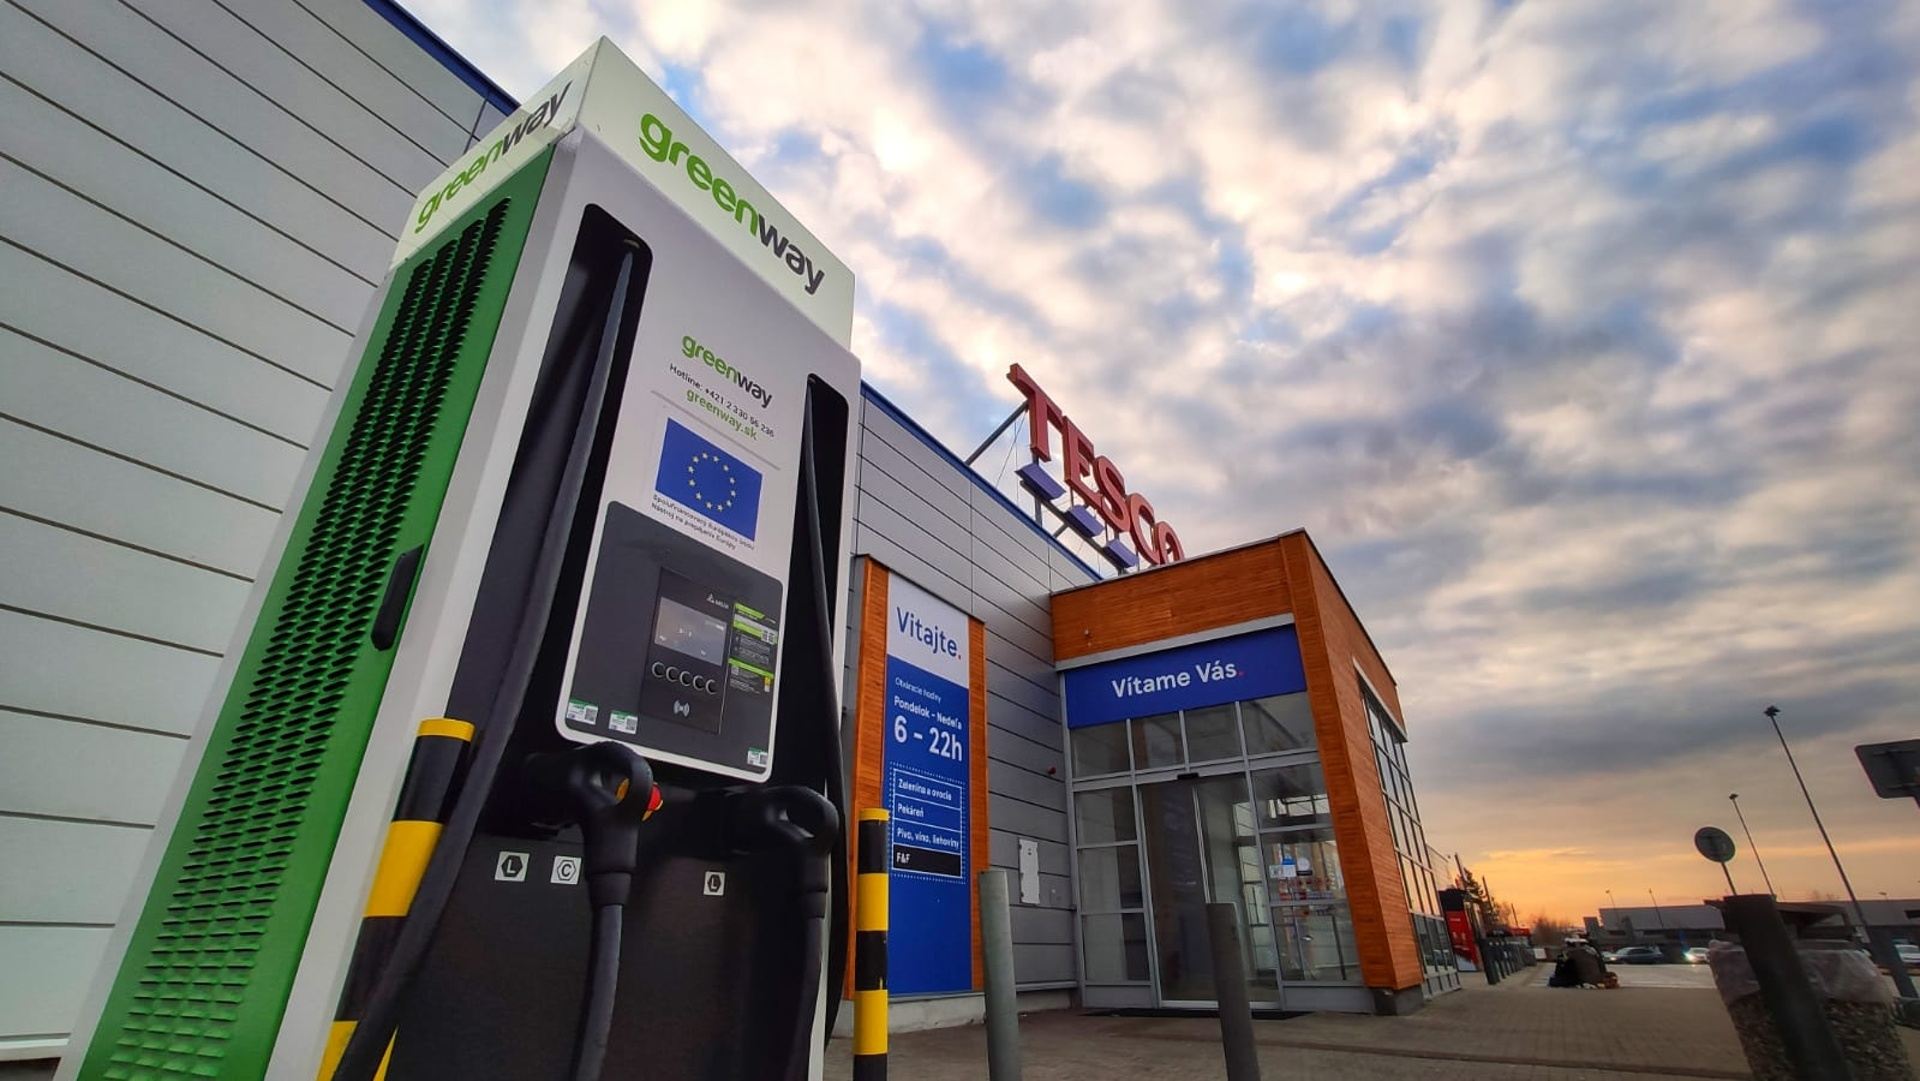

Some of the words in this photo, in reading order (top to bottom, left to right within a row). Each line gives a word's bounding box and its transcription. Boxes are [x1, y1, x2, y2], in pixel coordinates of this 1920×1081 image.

[413, 81, 572, 234] greenway
[638, 113, 826, 295] greenway
[669, 362, 703, 391] Hotline:
[681, 335, 773, 409] greenway
[686, 389, 757, 441] greenway.sk
[896, 606, 962, 661] Vitajte.
[1111, 672, 1191, 699] Vítame
[894, 694, 931, 719] Pondelok
[894, 714, 908, 744] 6
[928, 726, 963, 763] 22h
[506, 860, 517, 875] L
[560, 862, 573, 878] C
[896, 851, 911, 864] F&F
